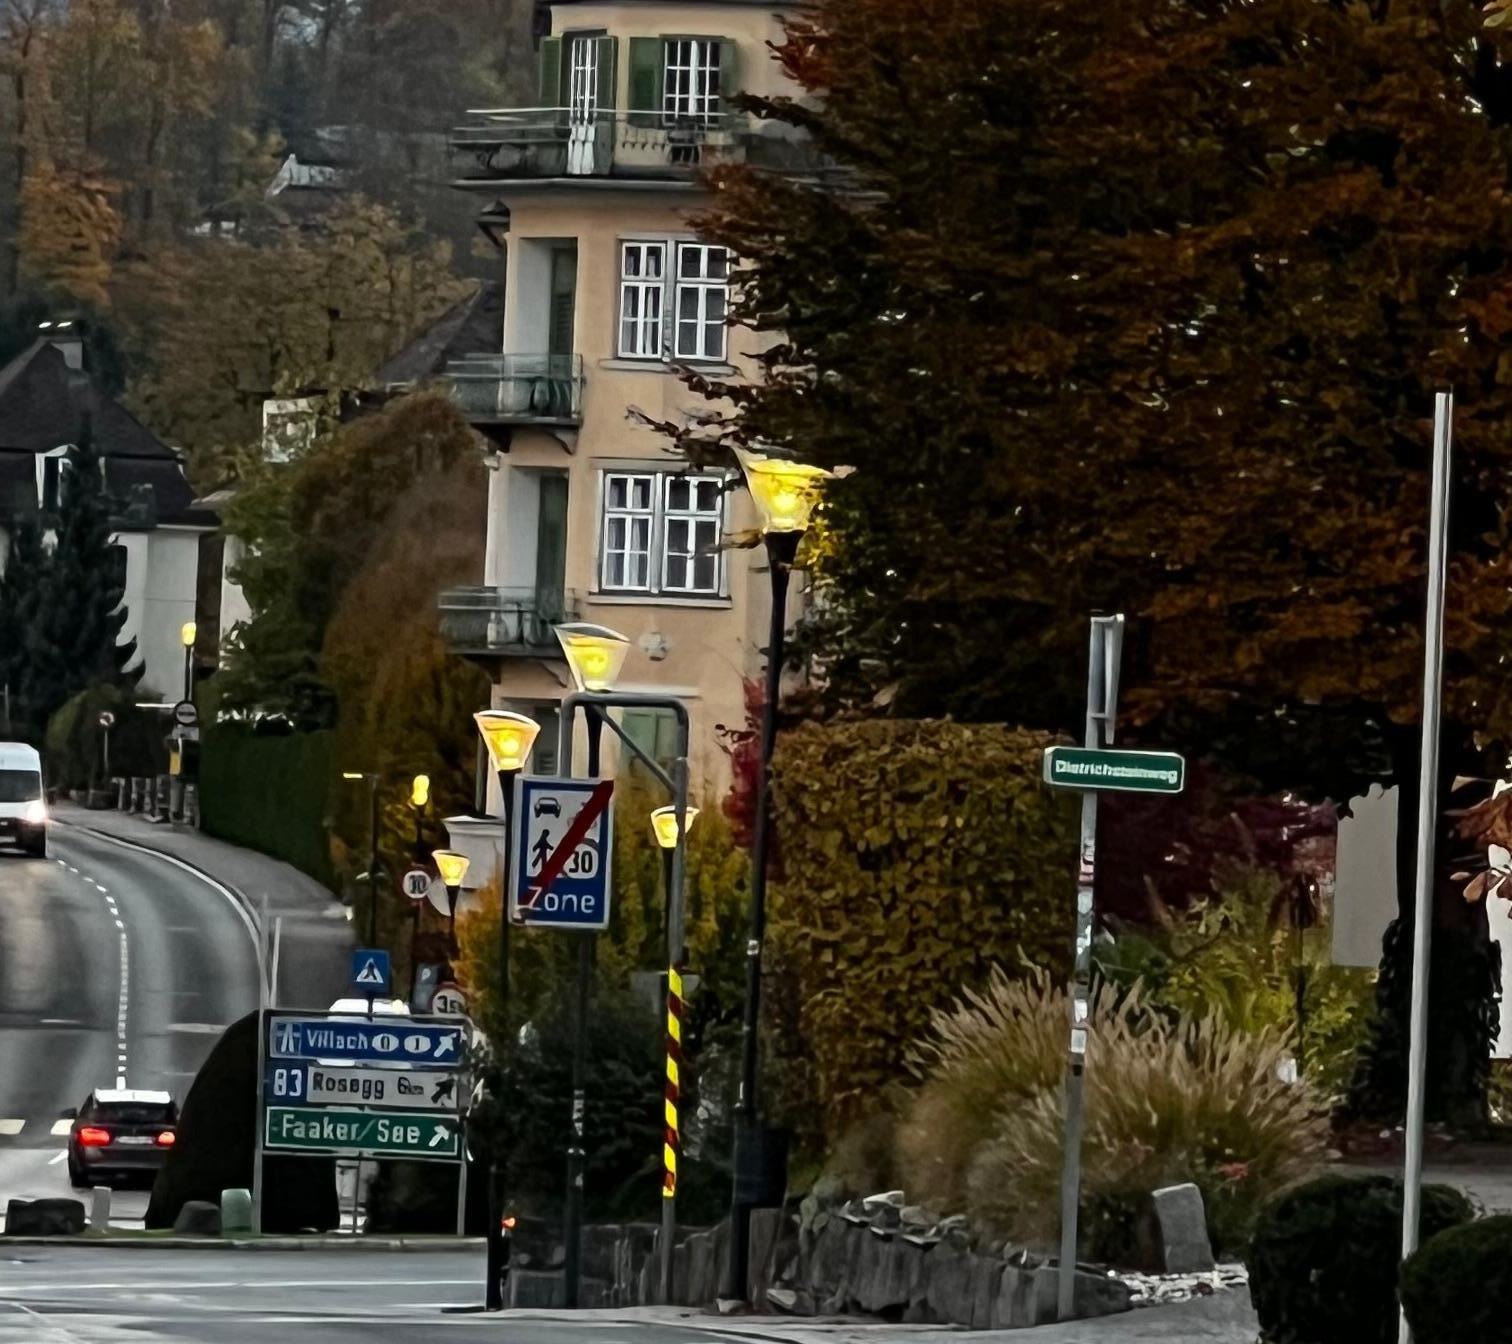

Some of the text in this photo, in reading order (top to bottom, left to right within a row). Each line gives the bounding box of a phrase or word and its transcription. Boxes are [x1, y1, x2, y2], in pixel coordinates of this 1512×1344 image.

[569, 850, 593, 873] 30
[527, 885, 596, 914] Zone
[306, 1029, 368, 1050] Villach
[313, 1072, 384, 1100] Rosegg
[282, 1113, 421, 1144] Faaker See
